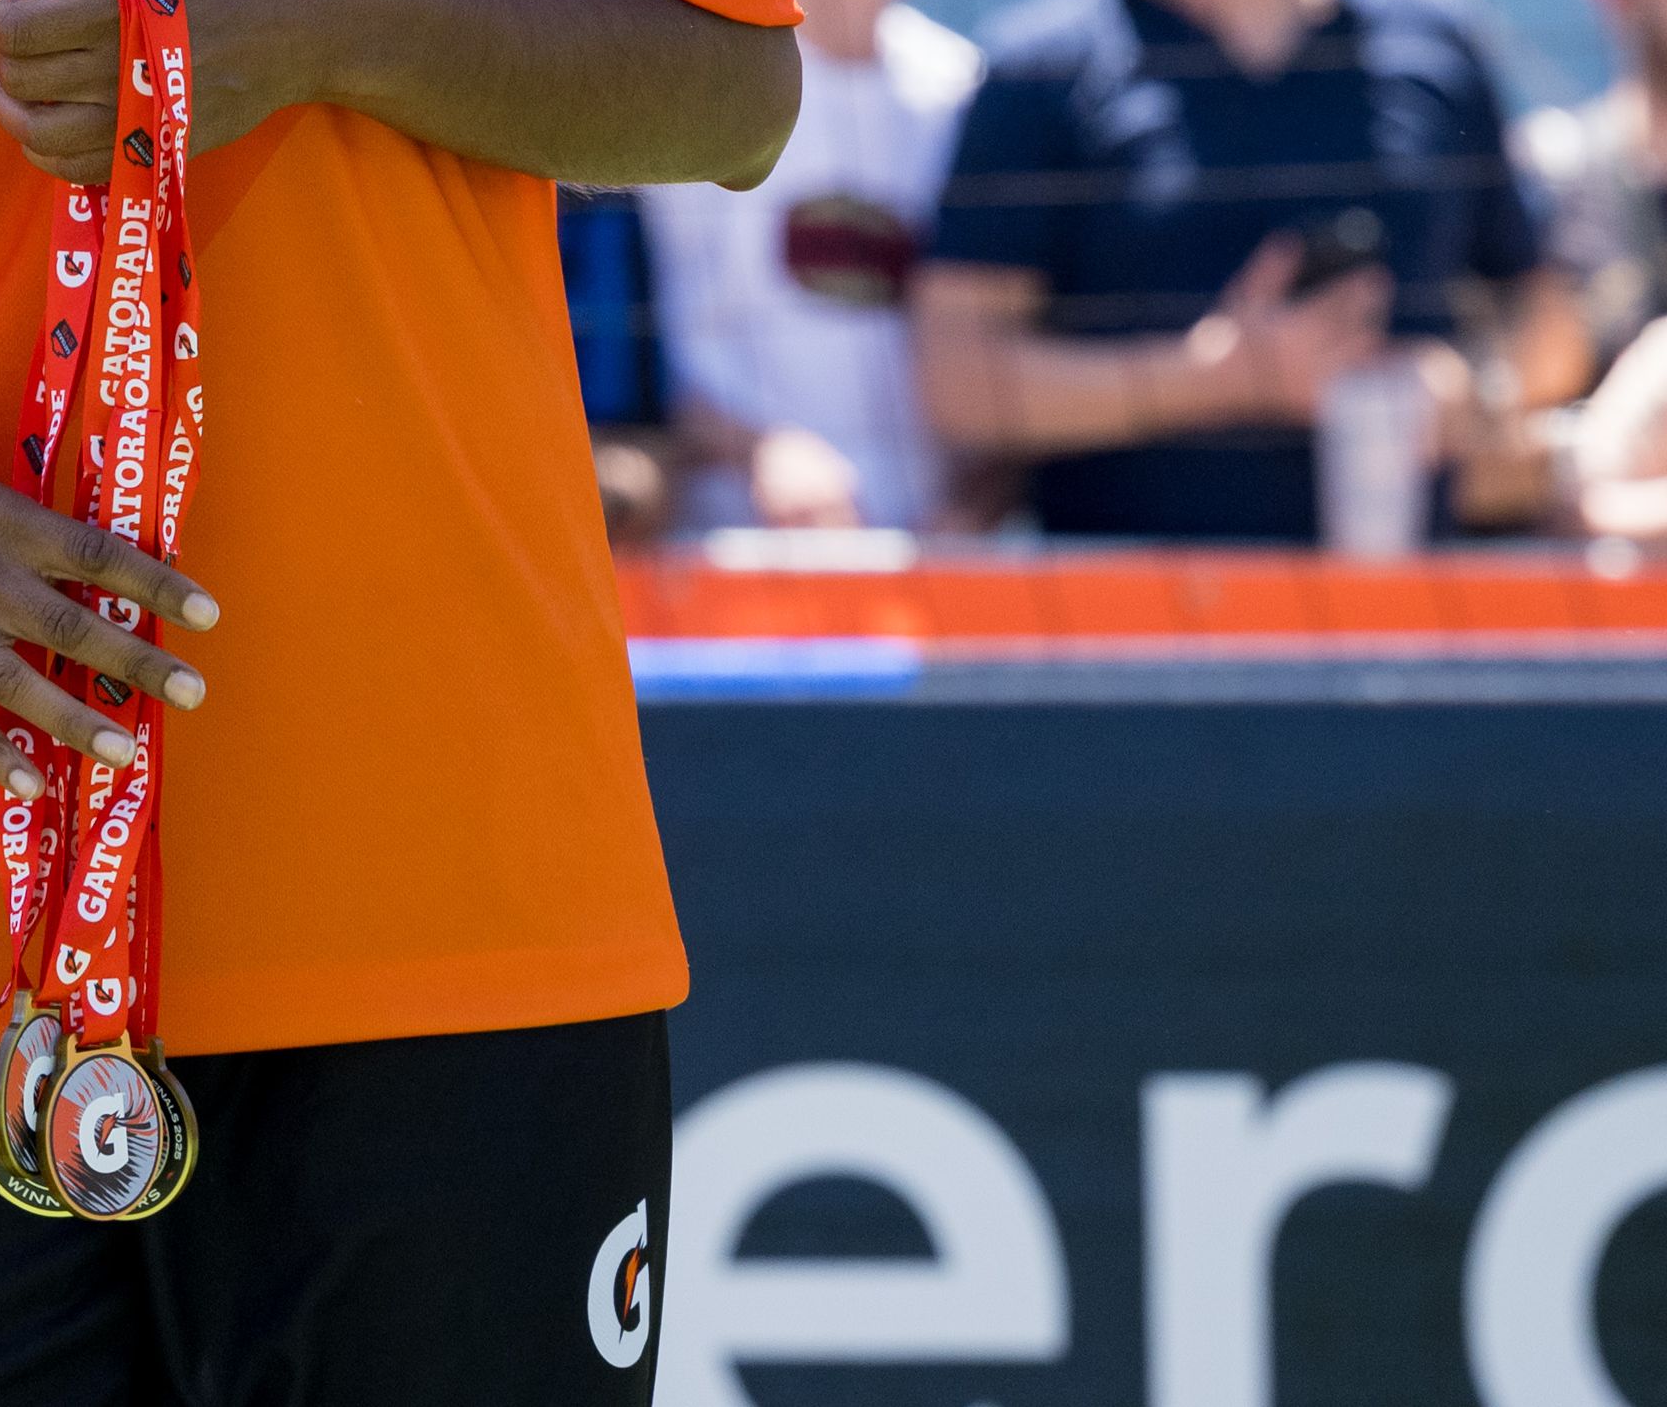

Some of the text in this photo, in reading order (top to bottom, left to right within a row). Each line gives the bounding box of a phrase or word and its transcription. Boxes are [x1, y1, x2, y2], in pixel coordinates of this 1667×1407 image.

[56, 250, 93, 288] G
[99, 197, 153, 407] GATORADE
[124, 300, 151, 409] GATO
[110, 408, 149, 547] ATORA
[77, 723, 150, 923] GATORADE
[56, 943, 91, 985] G
[86, 978, 122, 1016] G
[79, 1092, 129, 1173] G
[587, 1197, 650, 1368] G
